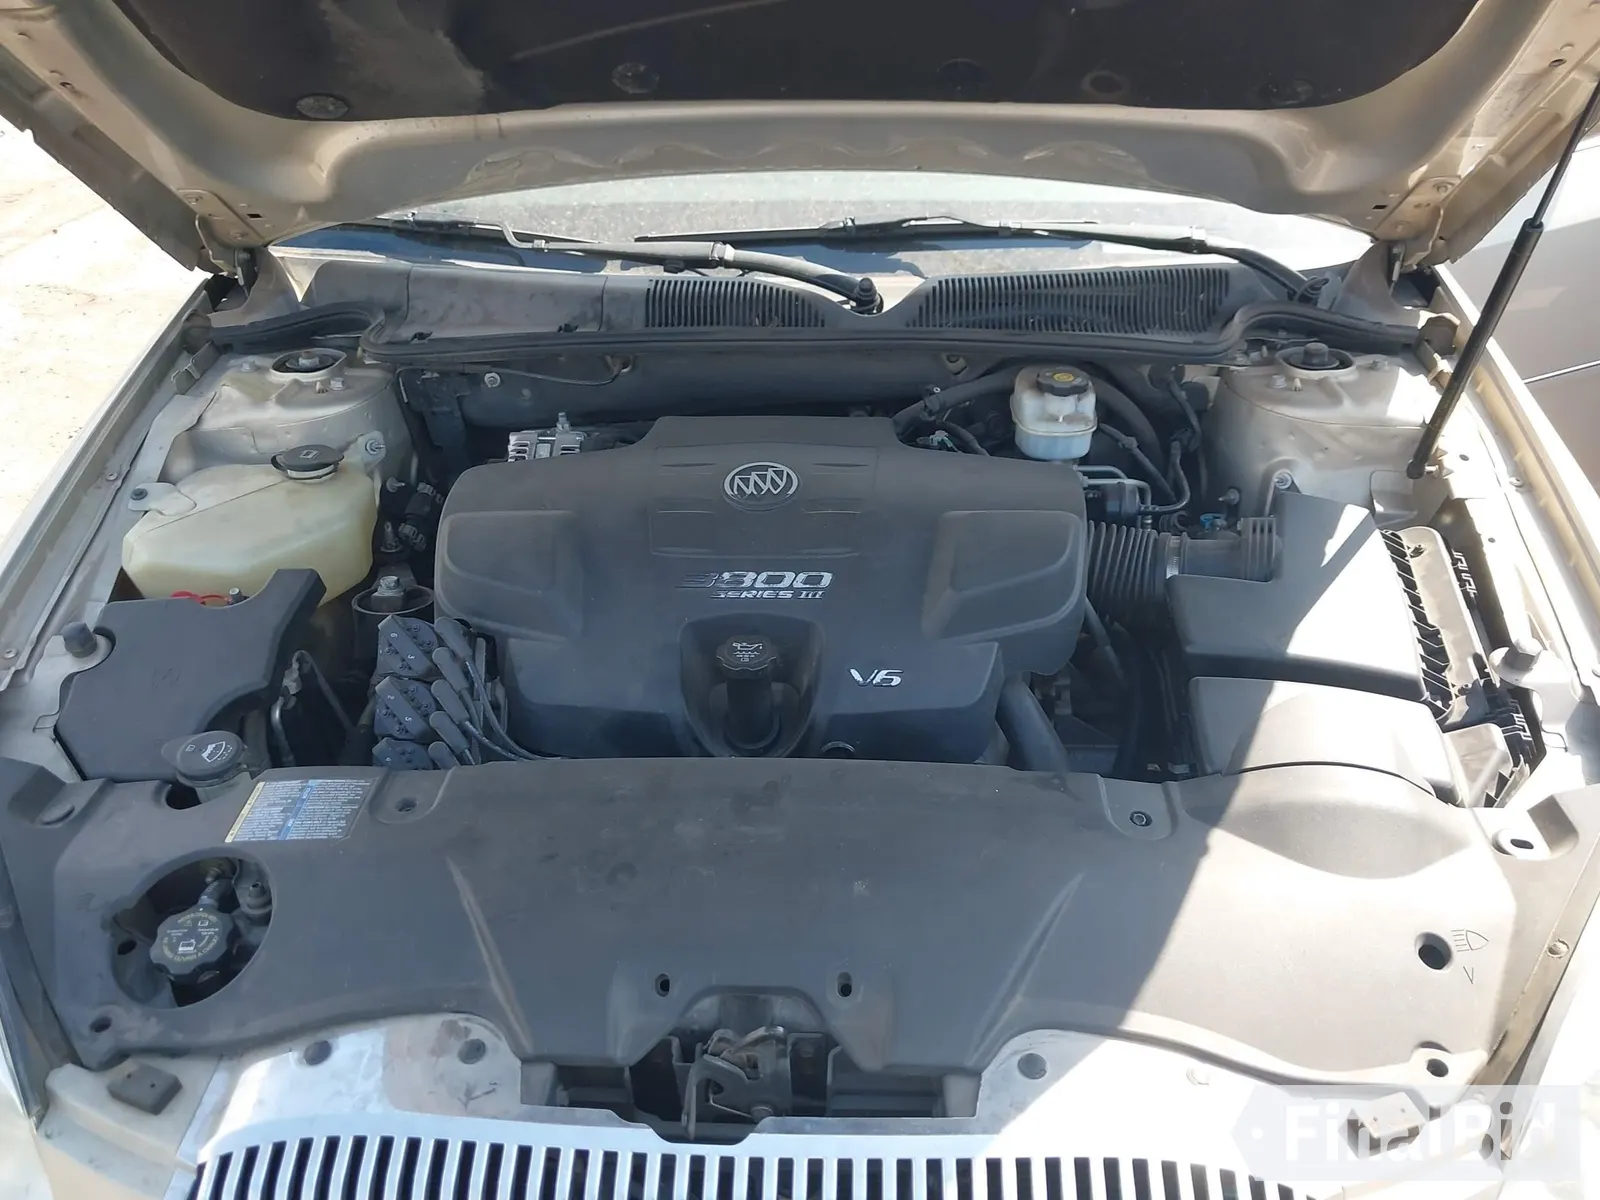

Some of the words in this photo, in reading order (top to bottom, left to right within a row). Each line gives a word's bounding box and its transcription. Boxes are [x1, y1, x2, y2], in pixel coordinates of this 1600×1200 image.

[676, 571, 833, 588] 3800
[711, 590, 794, 599] SERIES
[797, 590, 825, 599] III
[847, 667, 903, 686] V6
